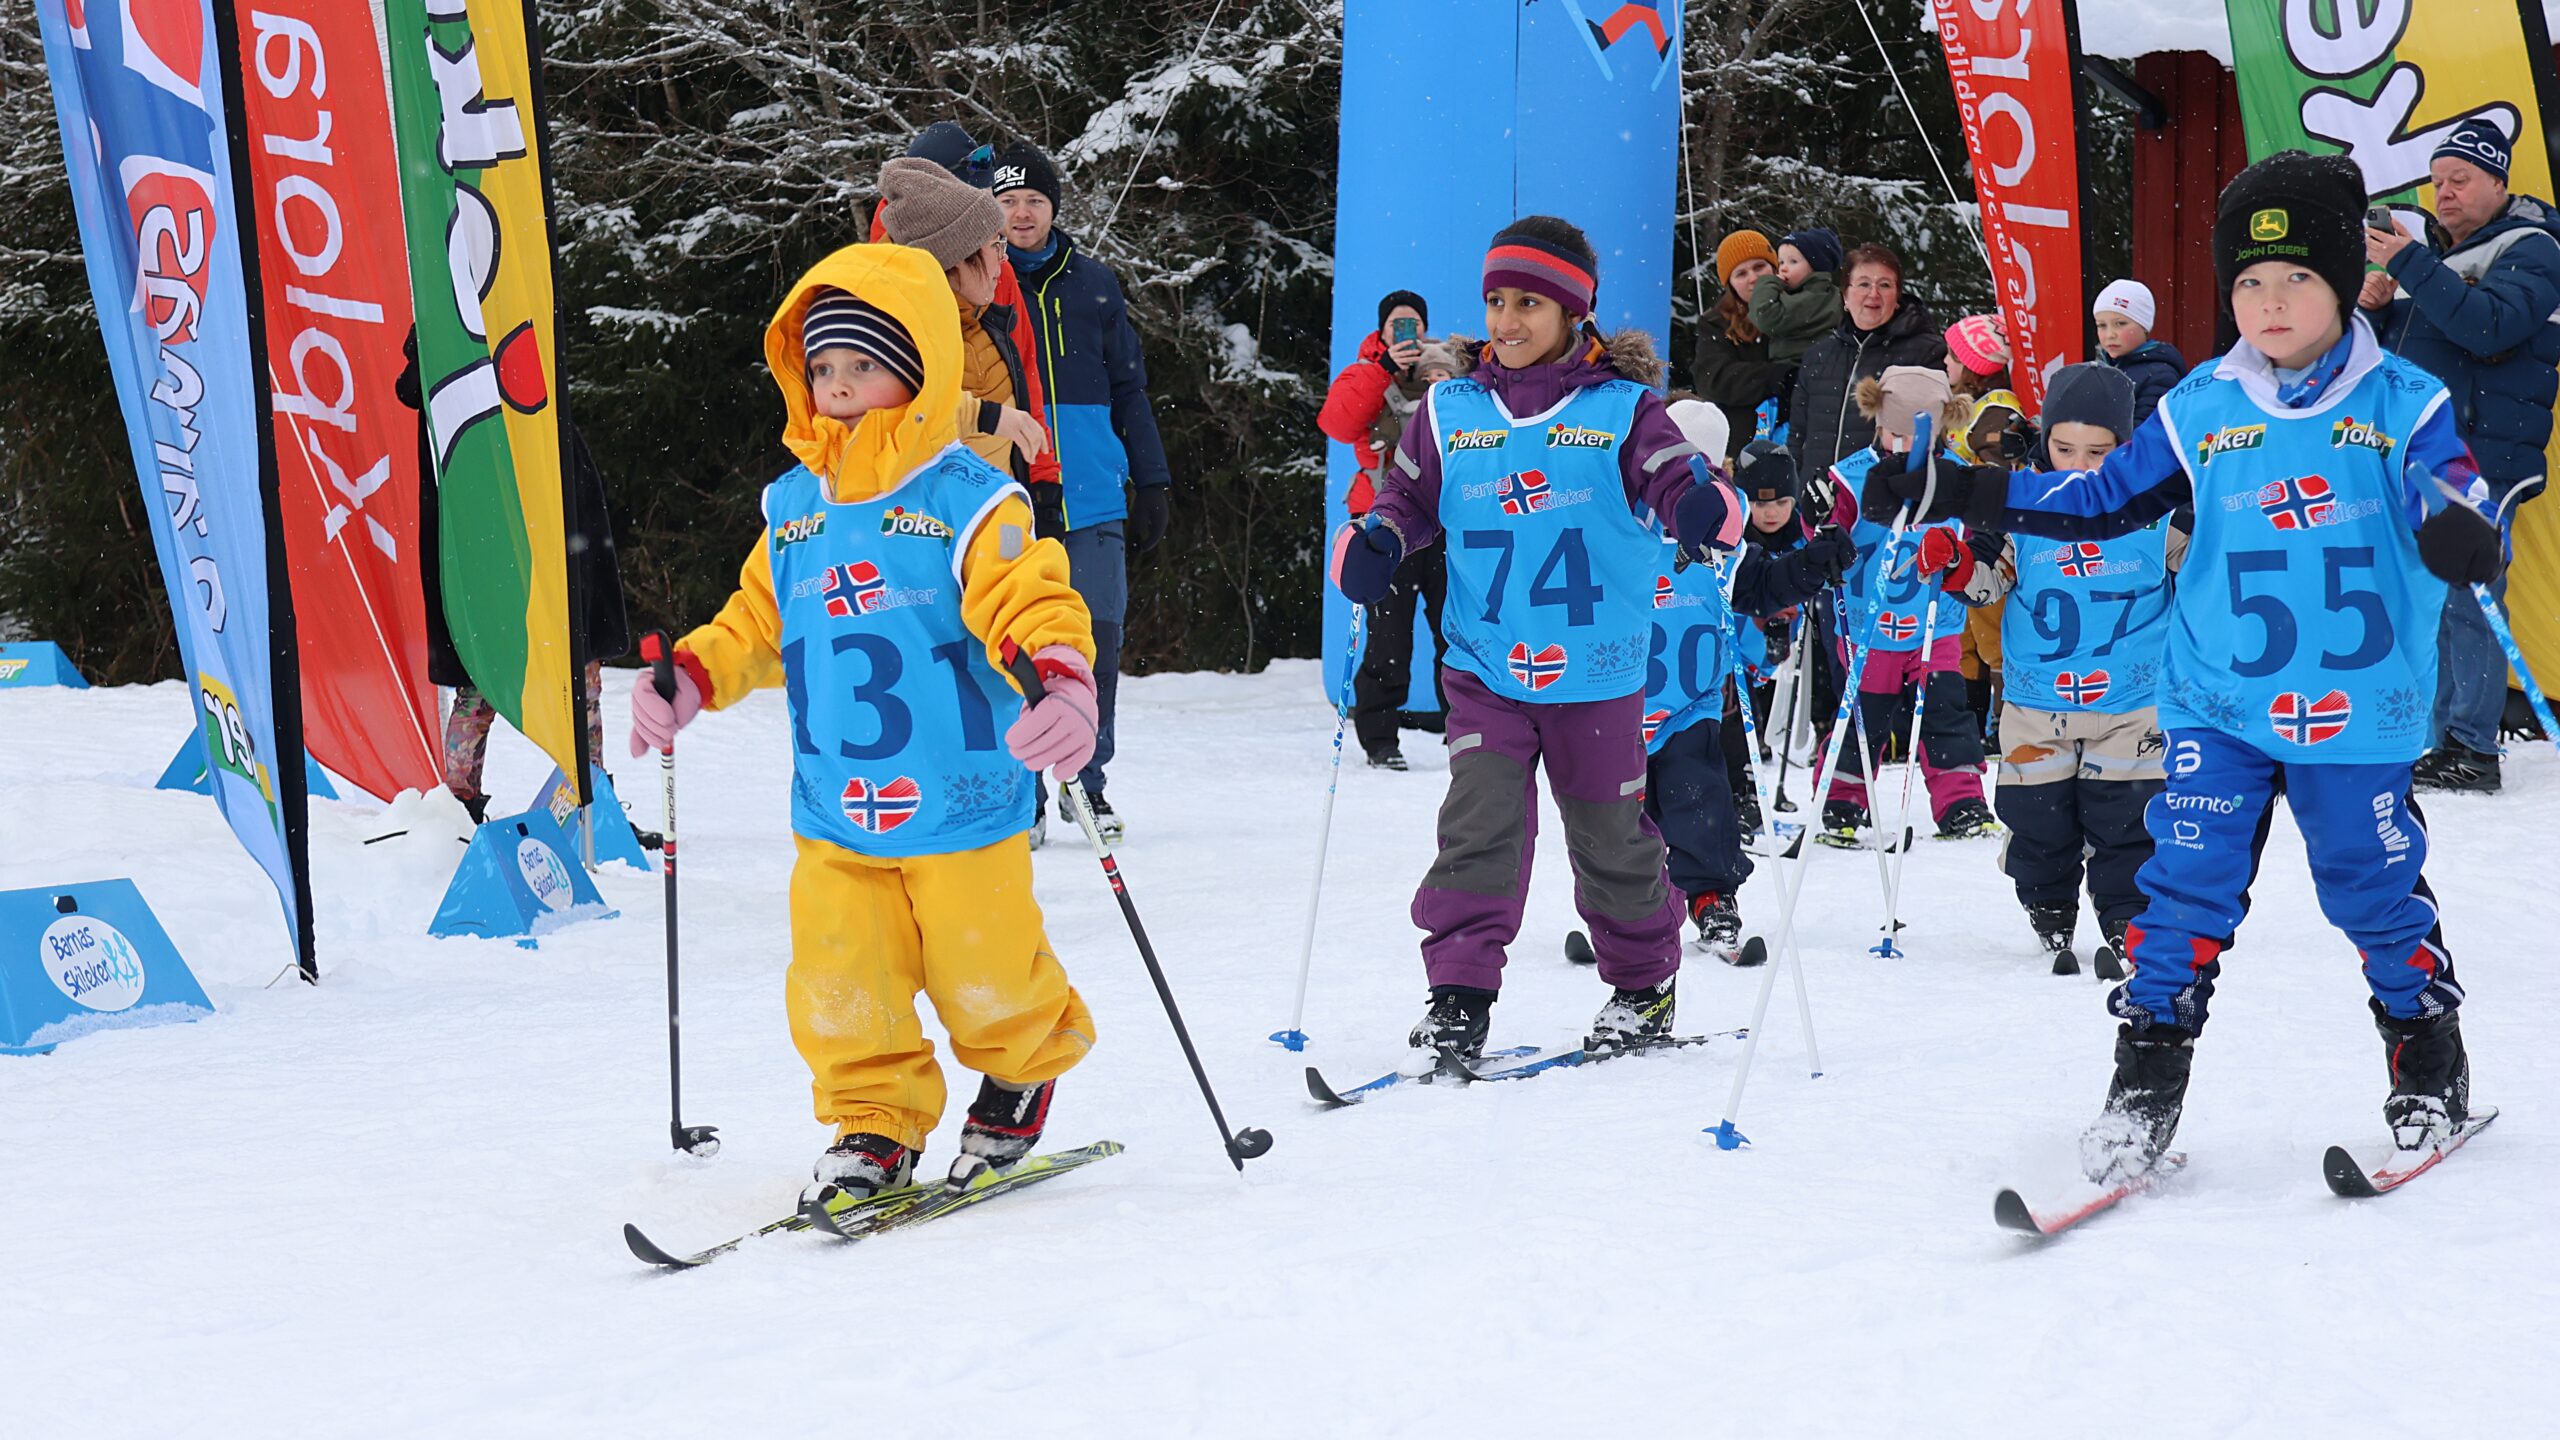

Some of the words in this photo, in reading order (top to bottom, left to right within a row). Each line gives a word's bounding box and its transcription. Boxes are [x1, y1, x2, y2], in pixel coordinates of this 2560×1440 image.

[2235, 247, 2266, 262] JOHN
[2267, 244, 2309, 257] DEERE
[1449, 427, 1503, 455] joker
[1549, 422, 1610, 449] joker
[1461, 476, 1511, 501] Barnas
[2222, 484, 2282, 512] arnas
[1462, 527, 1605, 627] 74
[2030, 587, 2137, 663] 97
[2226, 546, 2395, 679] 55
[781, 632, 998, 761] 131
[49, 926, 95, 961] Barnas
